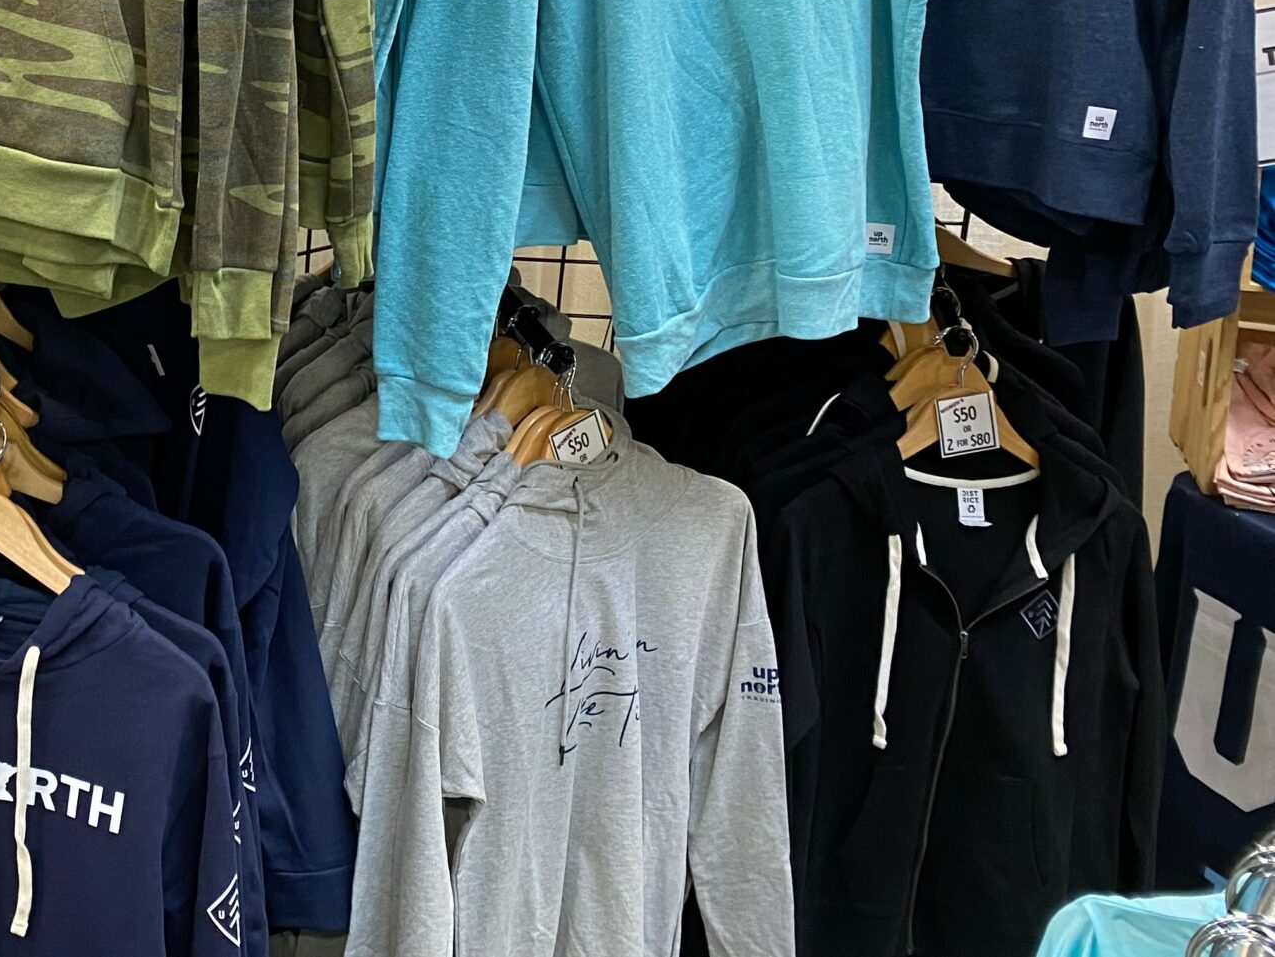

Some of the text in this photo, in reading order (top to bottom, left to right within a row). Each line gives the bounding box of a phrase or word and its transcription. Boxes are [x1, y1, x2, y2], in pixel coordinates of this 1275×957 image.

[953, 405, 977, 423] $50
[963, 425, 972, 433] OR
[568, 432, 589, 455] $50
[947, 432, 991, 451] 2 FOR $80
[579, 453, 588, 463] OR
[752, 666, 779, 684] up
[740, 681, 779, 695] nor
